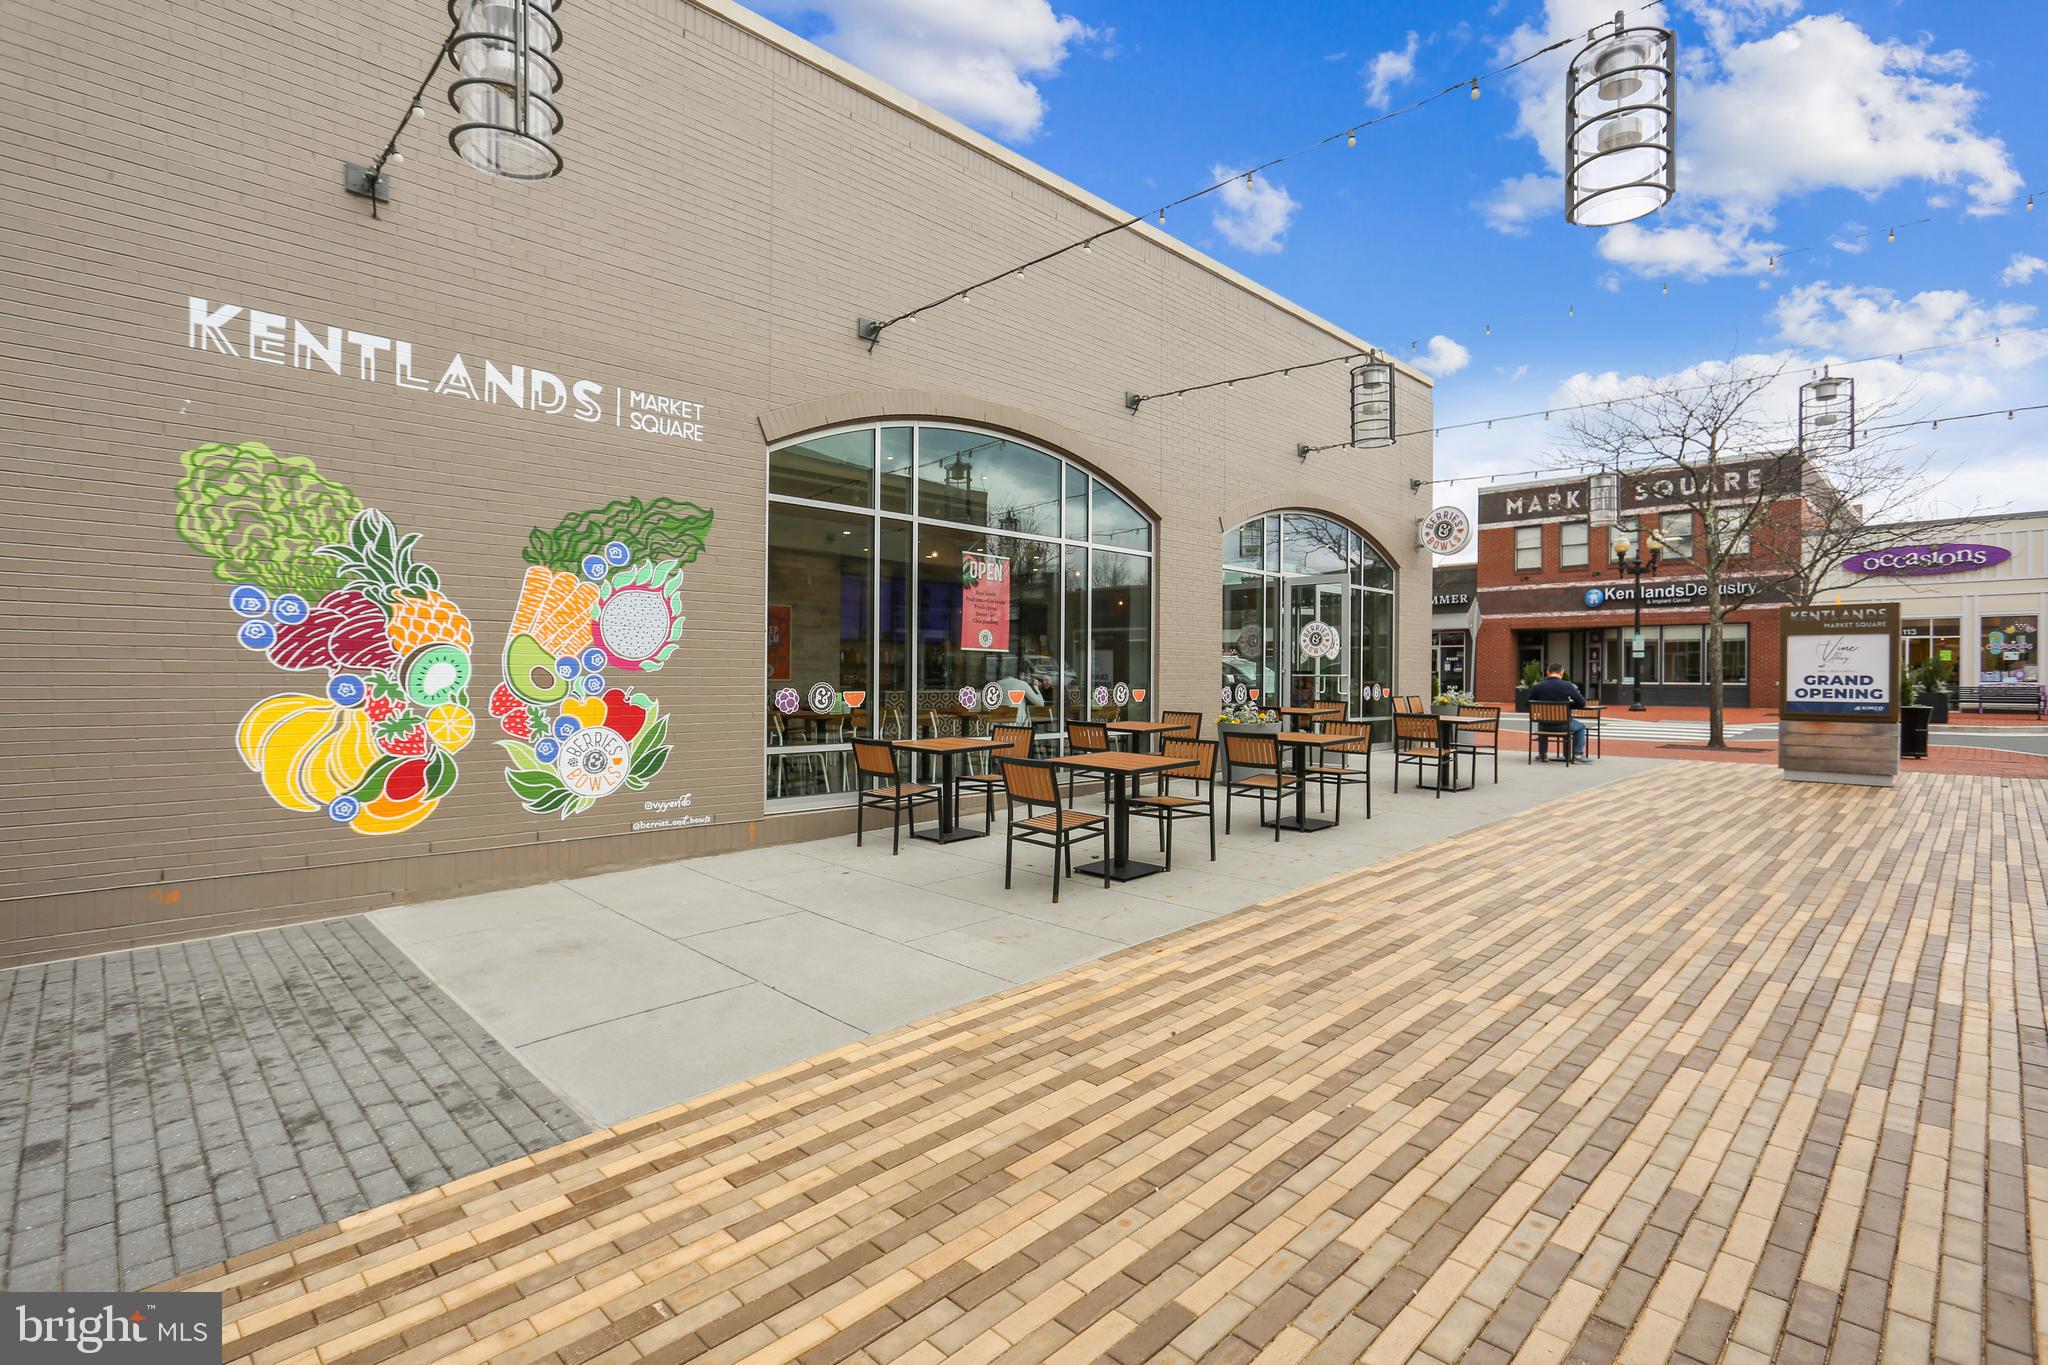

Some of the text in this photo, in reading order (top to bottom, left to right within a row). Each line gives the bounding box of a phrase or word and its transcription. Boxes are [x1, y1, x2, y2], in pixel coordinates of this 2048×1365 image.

[188, 295, 602, 423] KENTLANDS
[630, 389, 704, 421] MARKET
[630, 412, 704, 442] SQUARE
[1507, 488, 1588, 515] MARK
[1425, 510, 1463, 530] BERRIES
[1437, 523, 1451, 537] &
[1426, 534, 1462, 550] BOWLS
[969, 560, 1003, 582] OPEN
[1790, 608, 1887, 621] KENTLANDS
[1303, 624, 1330, 638] BERRIES
[1303, 643, 1328, 654] BOWLS
[1803, 674, 1874, 686] GRAND
[1794, 688, 1884, 700] OPENING
[566, 732, 623, 758] BERRIES
[587, 752, 604, 771] &
[566, 765, 622, 792] BOWLS
[644, 792, 692, 813] @vyyendo
[632, 815, 712, 831] @berries_and_bowls
